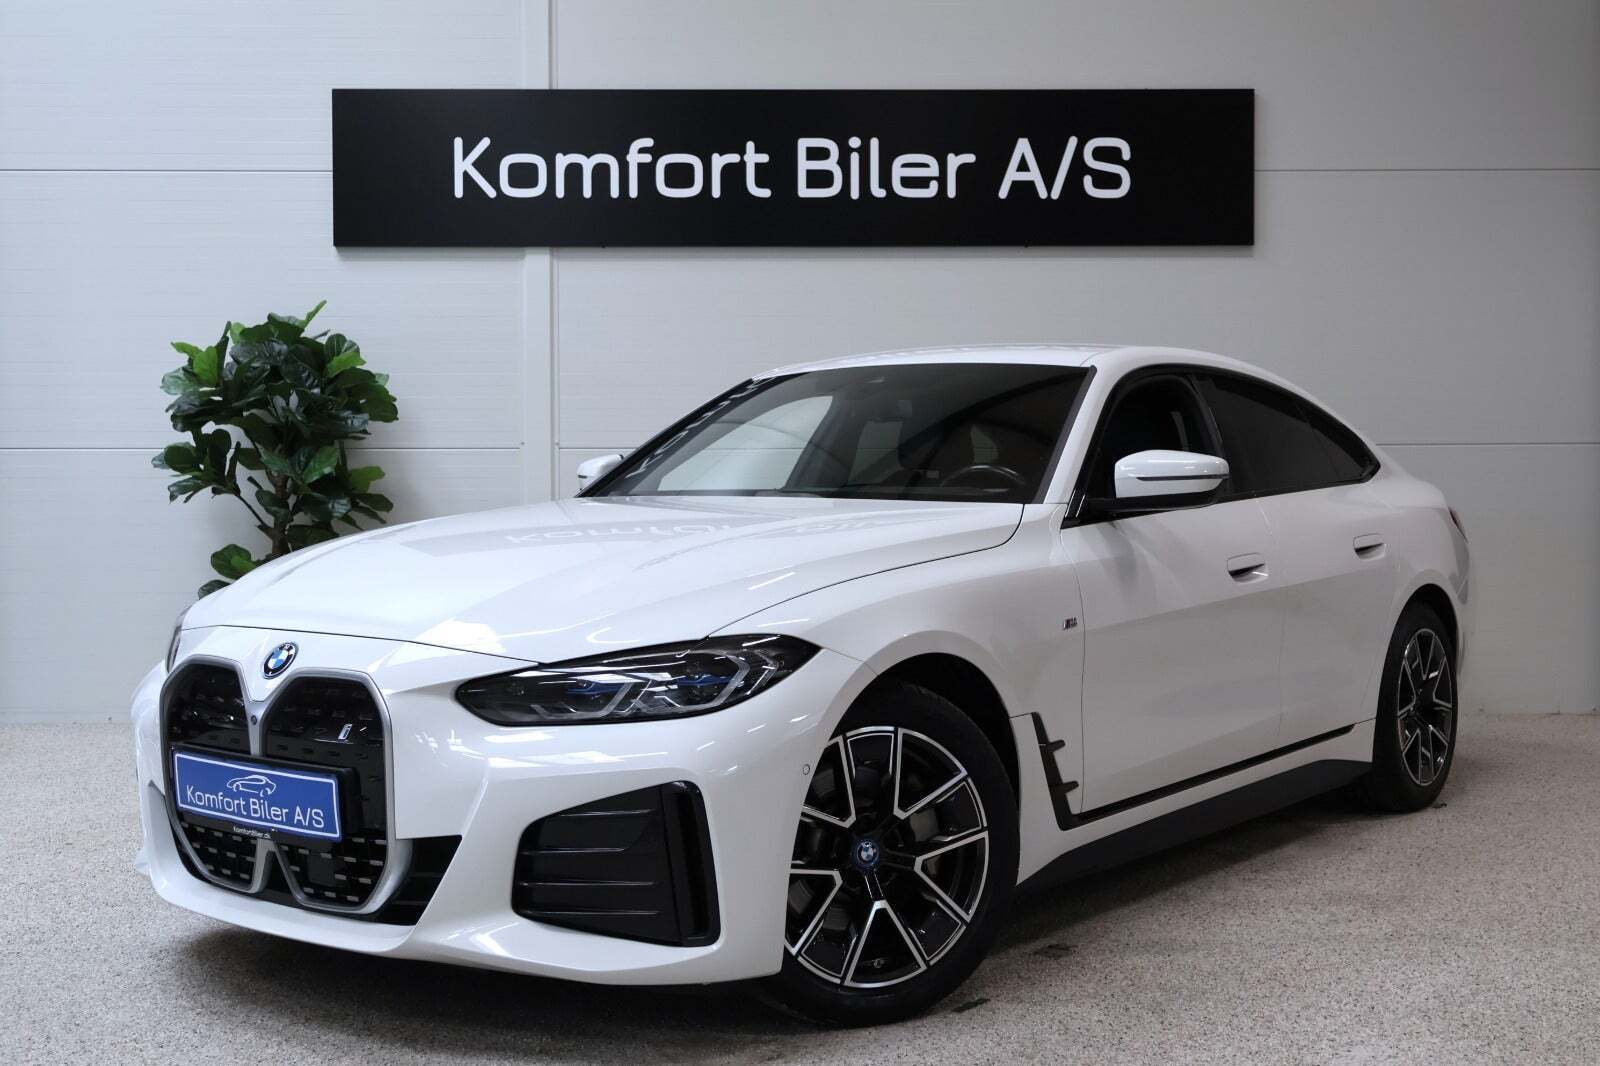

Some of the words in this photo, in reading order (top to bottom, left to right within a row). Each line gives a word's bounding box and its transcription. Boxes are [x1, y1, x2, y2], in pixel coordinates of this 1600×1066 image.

[453, 136, 772, 199] Komfort
[797, 136, 977, 199] Biler
[998, 136, 1131, 200] A/S
[186, 784, 247, 816] Komfort
[249, 797, 289, 823] Biler
[293, 805, 325, 829] A/S
